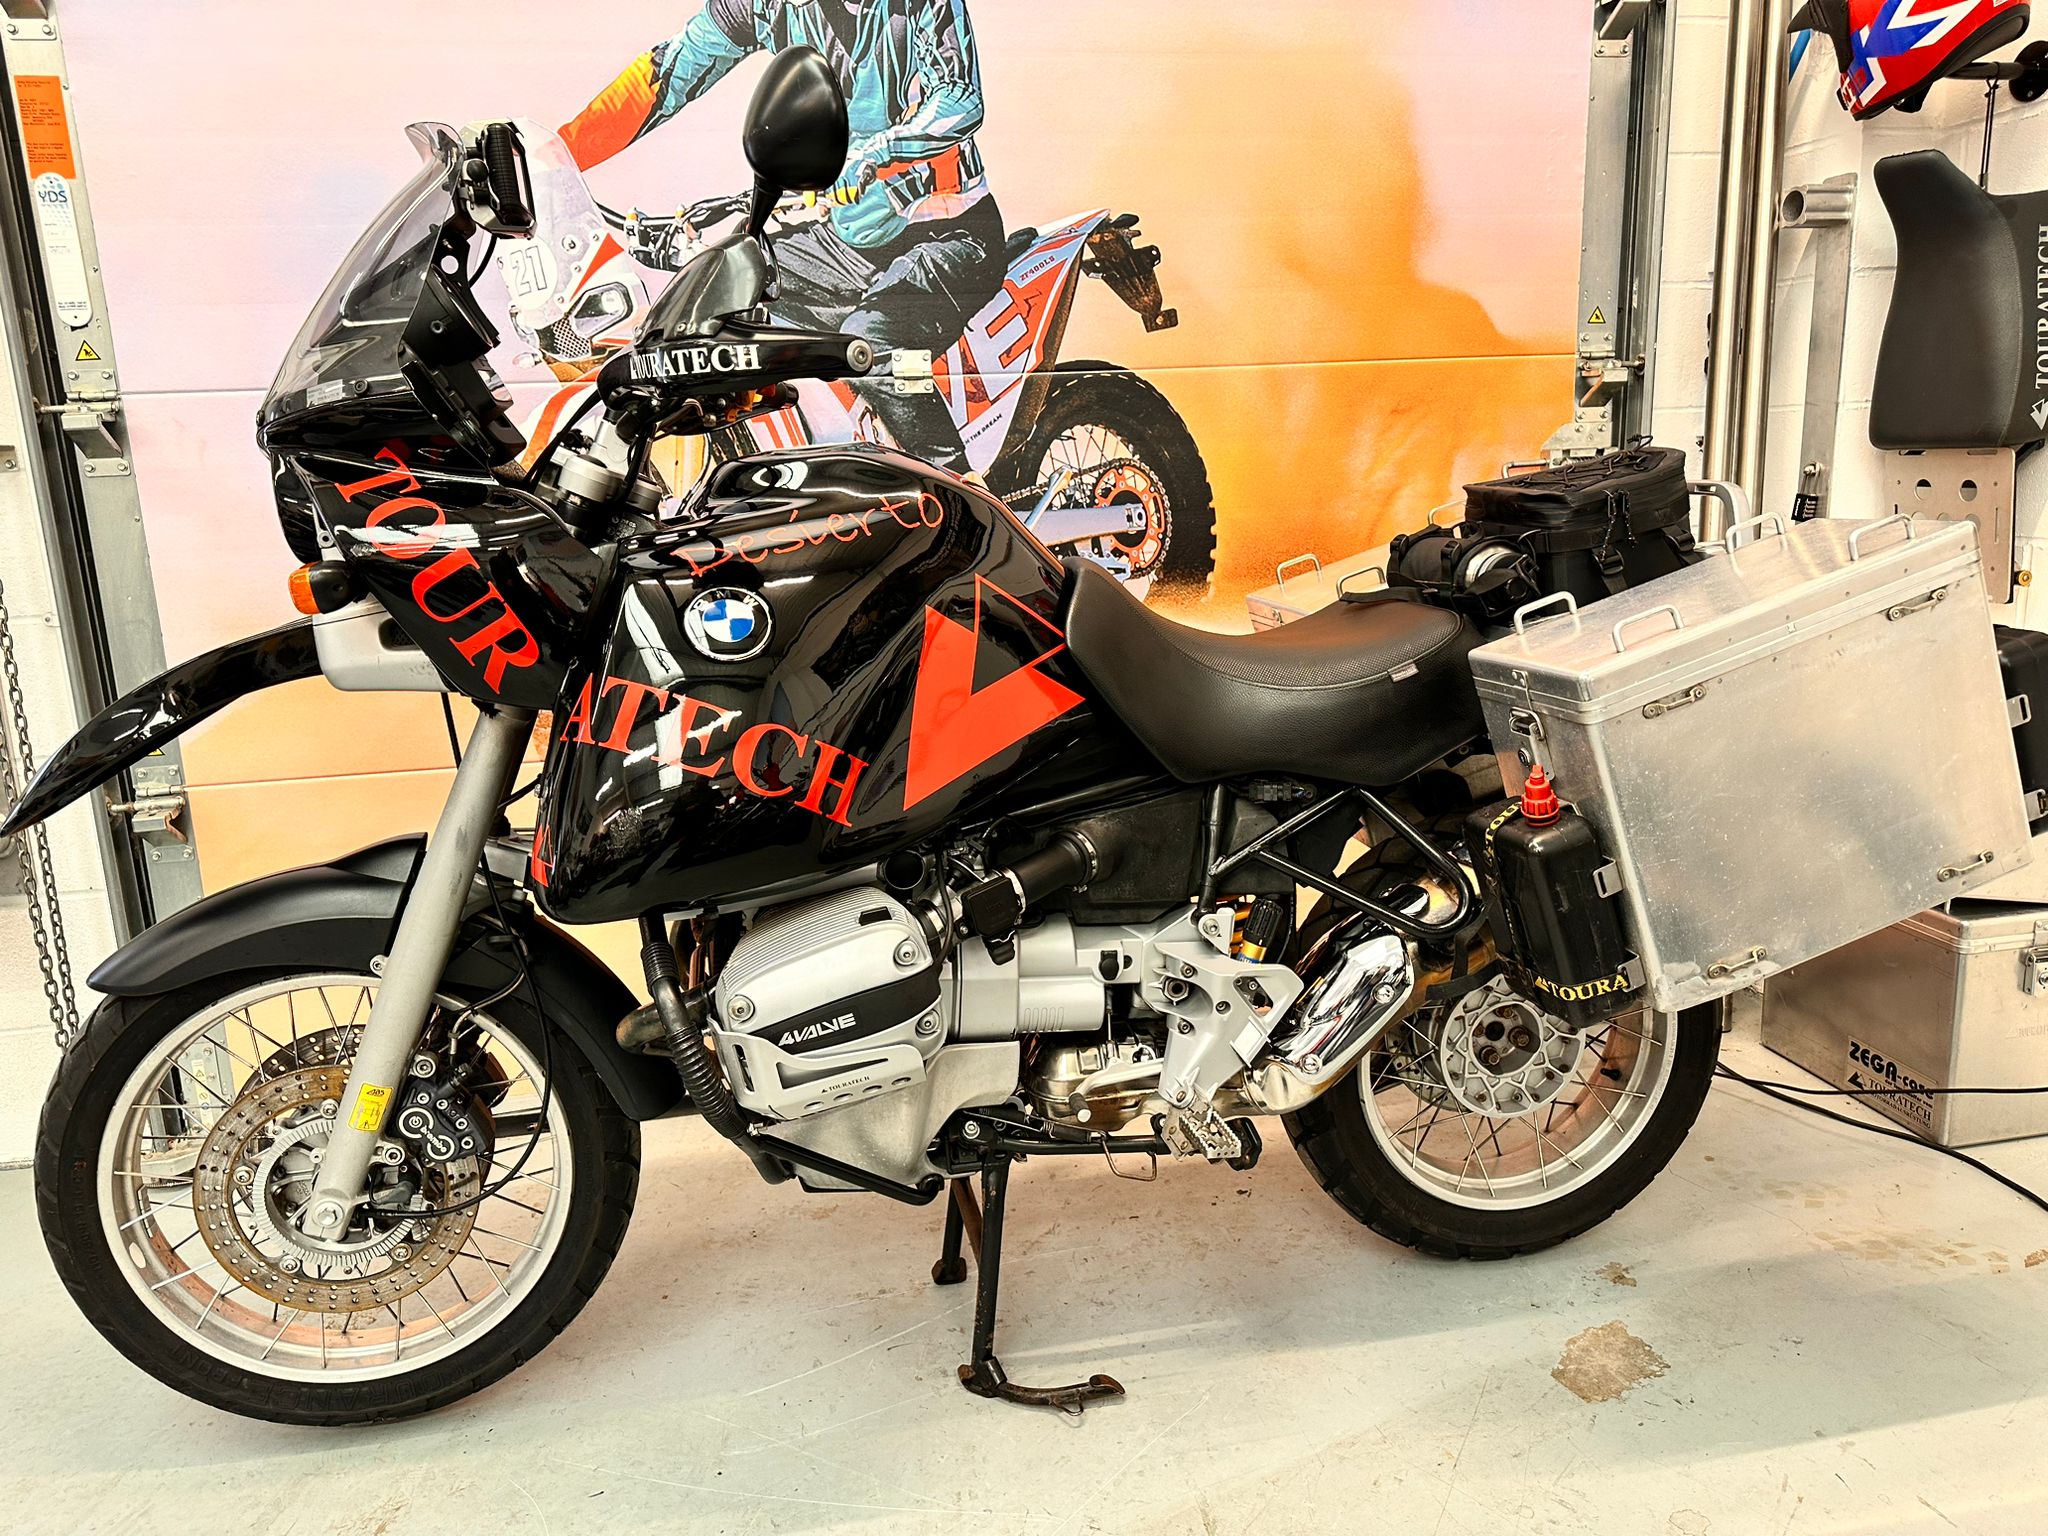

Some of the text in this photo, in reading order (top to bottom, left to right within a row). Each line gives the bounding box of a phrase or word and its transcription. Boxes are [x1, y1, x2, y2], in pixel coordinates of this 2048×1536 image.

[38, 190, 68, 203] YDS
[509, 245, 548, 296] 21
[636, 344, 762, 379] TOURATECH
[981, 413, 1002, 432] DREAM
[778, 1012, 857, 1047] 4VALVE
[829, 1076, 870, 1092] TOURATECH
[419, 1125, 448, 1153] brembo
